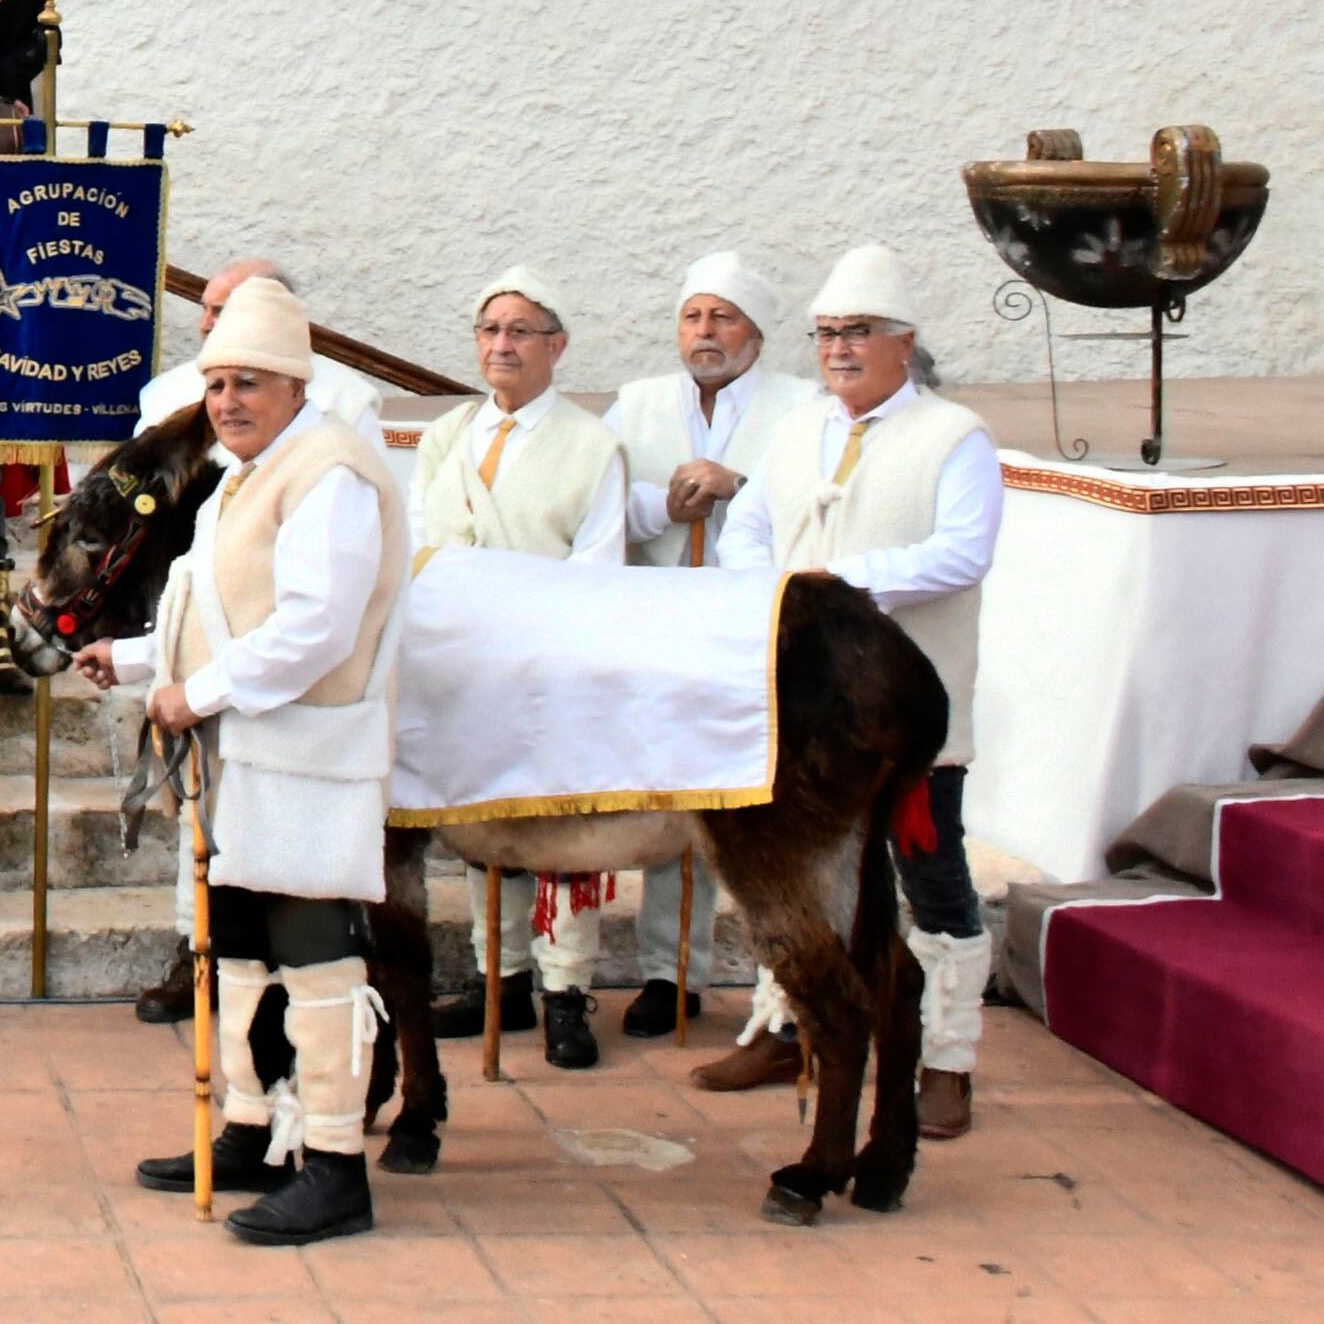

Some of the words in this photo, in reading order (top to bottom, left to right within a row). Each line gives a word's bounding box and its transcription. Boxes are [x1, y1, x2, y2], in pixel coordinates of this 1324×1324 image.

[7, 182, 129, 218] AGRUPACIÓN
[57, 211, 81, 227] DE
[26, 239, 104, 265] FIESTAS
[71, 365, 83, 382] Y
[87, 349, 142, 381] REYES
[12, 400, 82, 415] VIRTUDES
